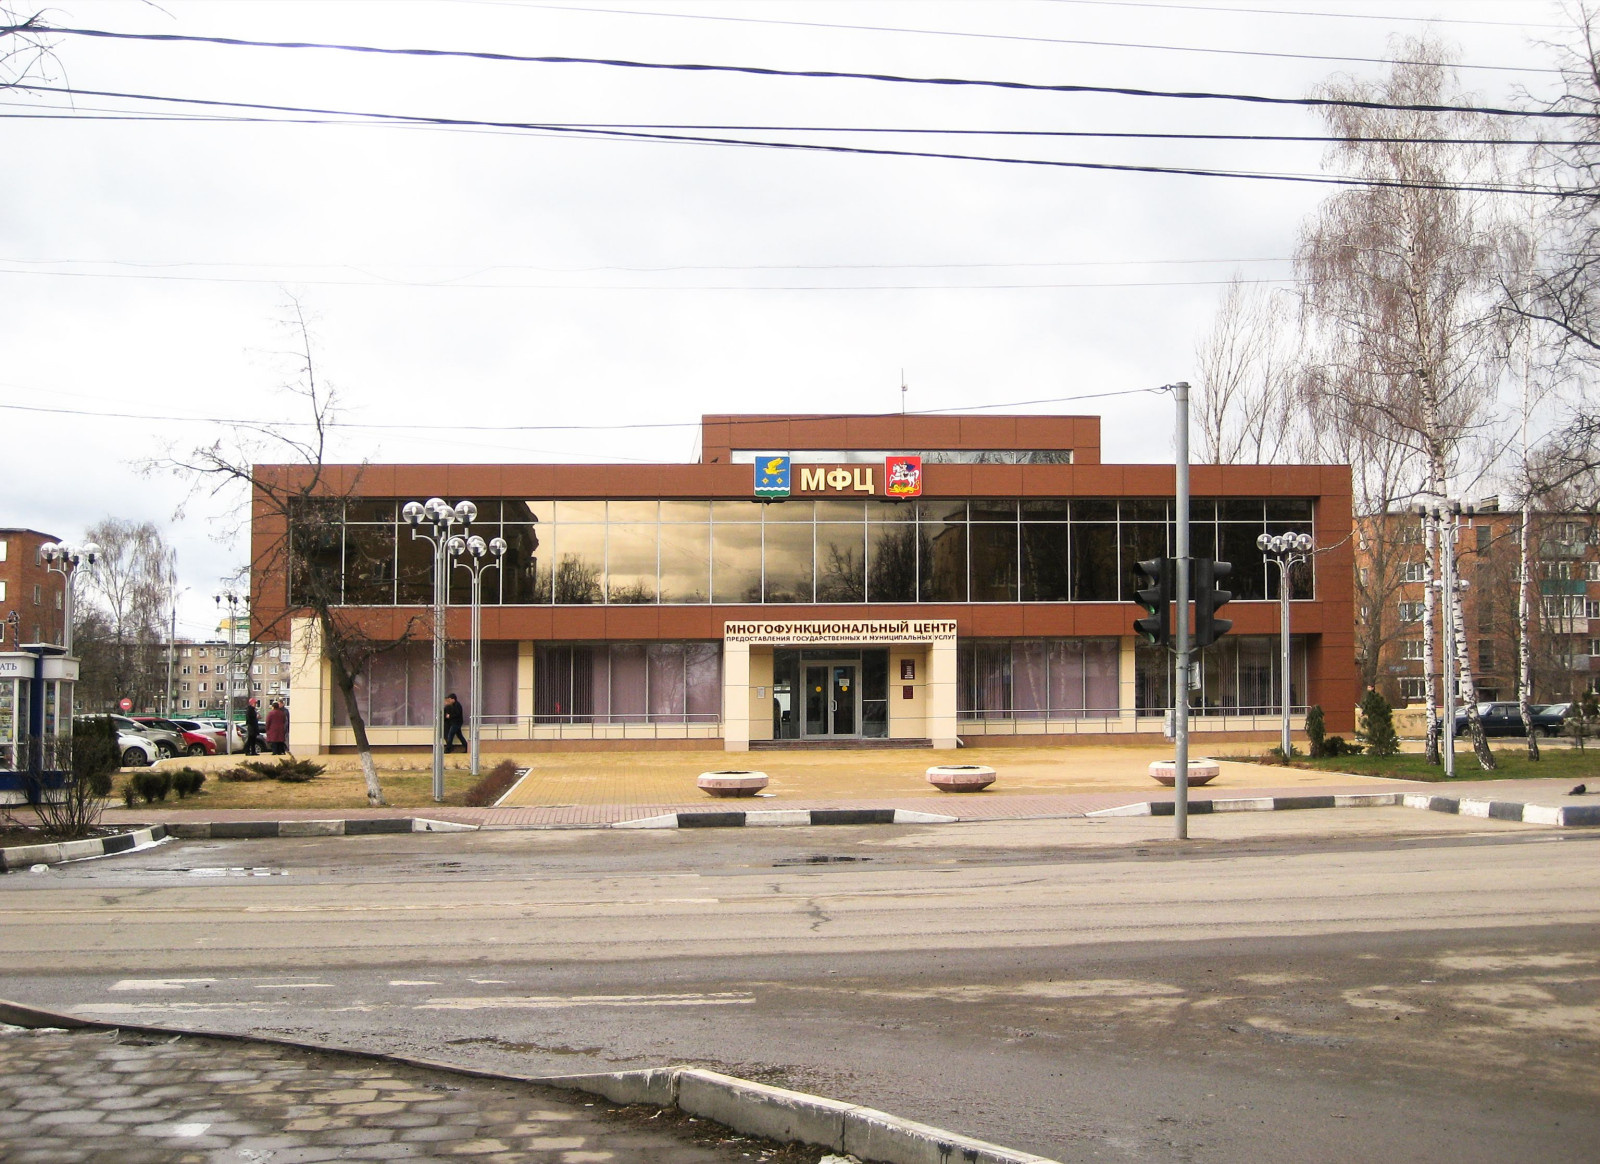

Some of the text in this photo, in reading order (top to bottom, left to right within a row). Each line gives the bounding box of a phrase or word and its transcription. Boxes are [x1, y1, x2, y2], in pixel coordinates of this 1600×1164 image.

[800, 468, 875, 494] МФЦ
[726, 621, 956, 635] МНОГОФУНКЦИОНАЛЬНЫЙ ЦЕНТР
